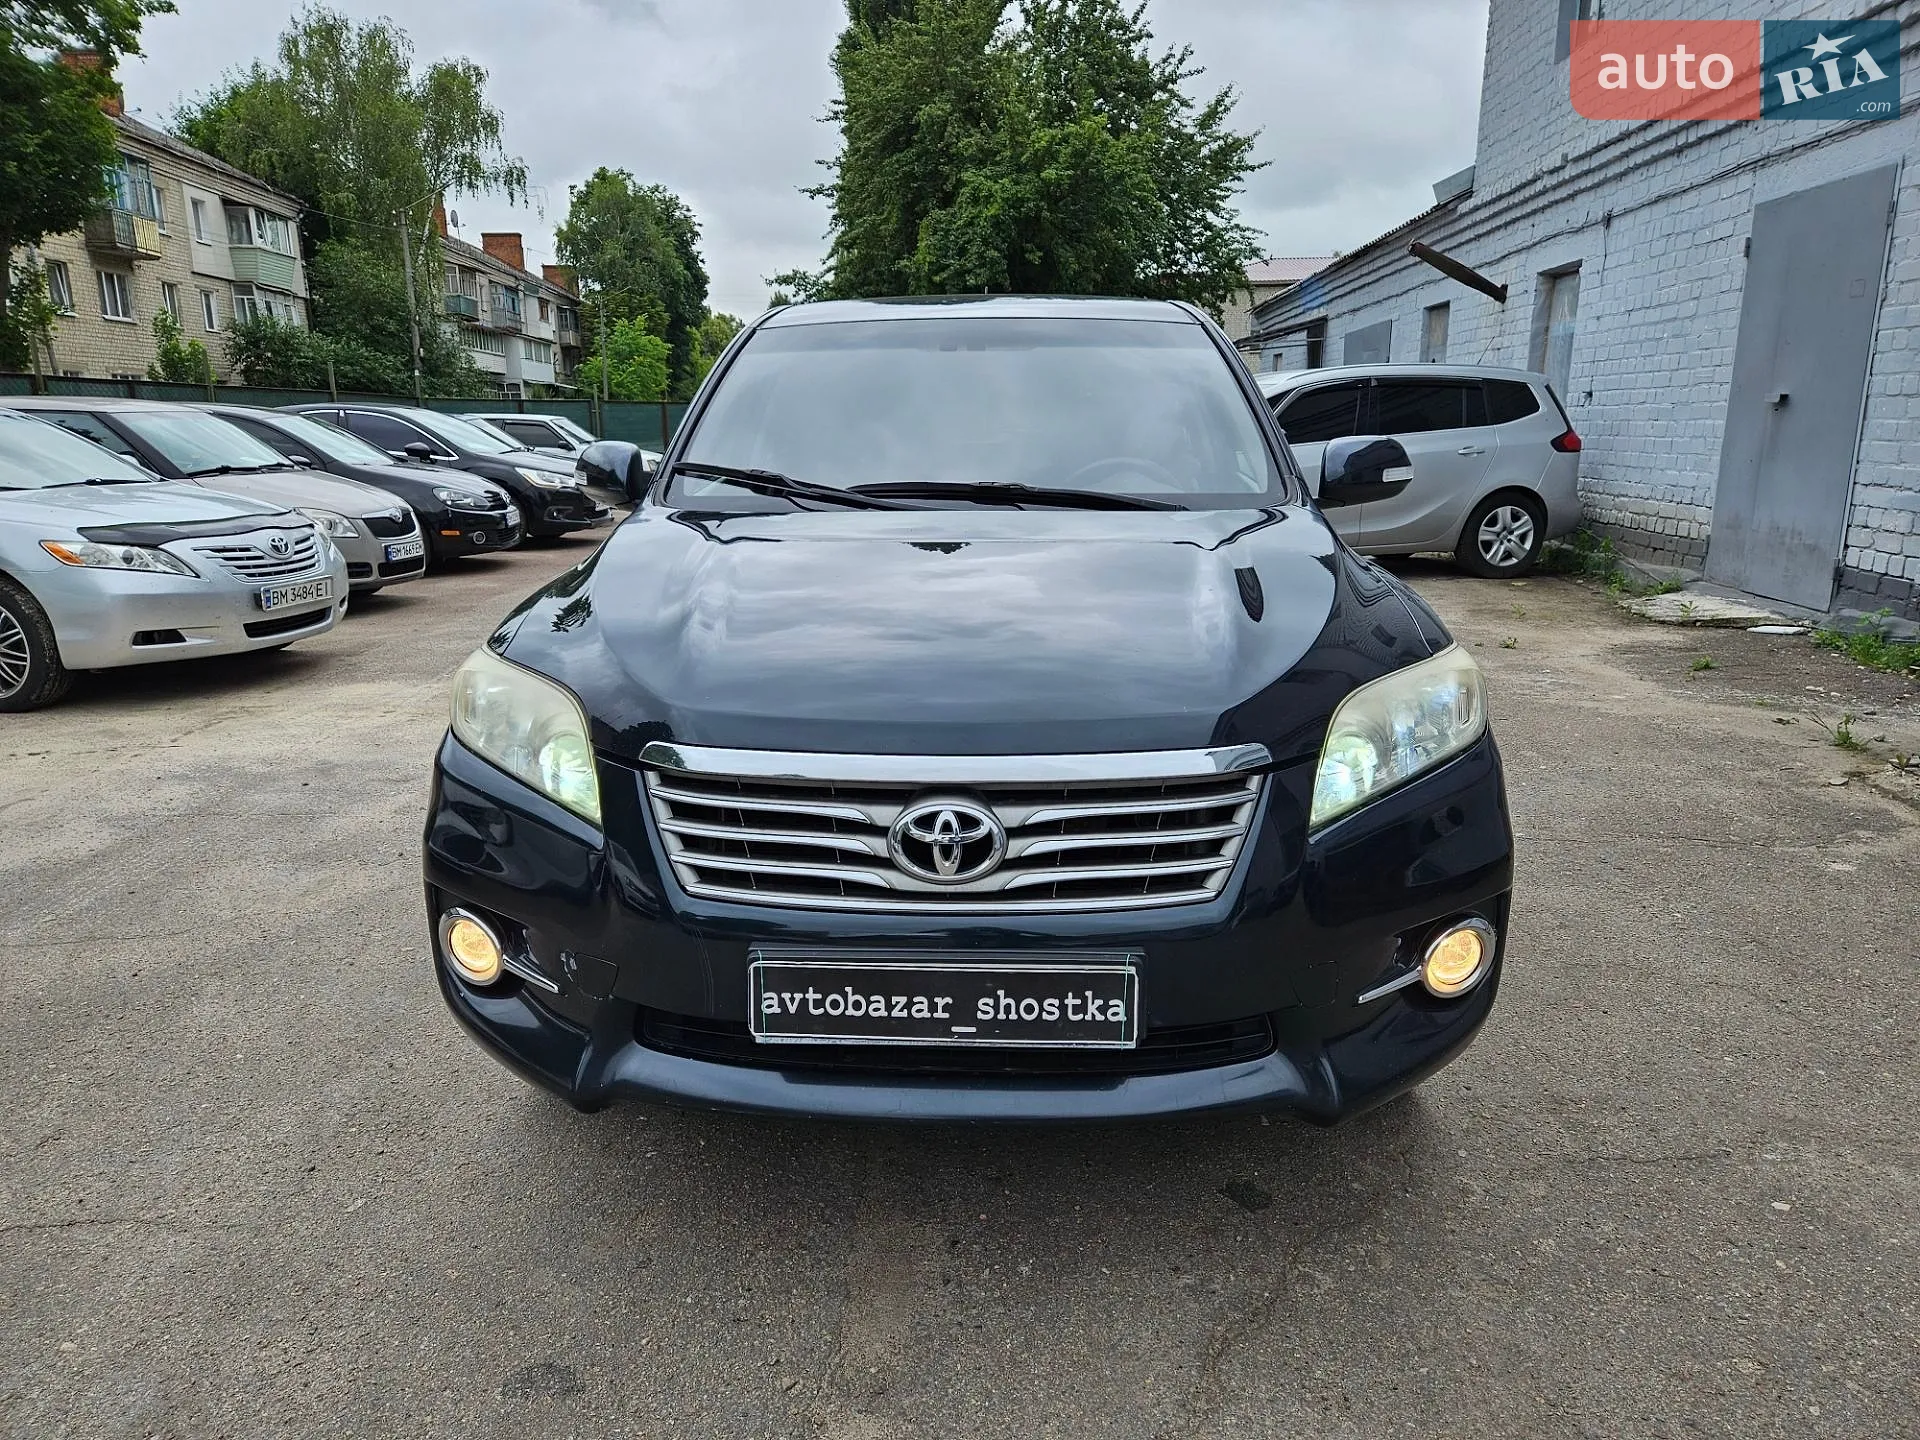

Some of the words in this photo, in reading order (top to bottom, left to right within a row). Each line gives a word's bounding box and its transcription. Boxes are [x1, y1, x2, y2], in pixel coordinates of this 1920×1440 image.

[272, 588, 288, 606] BM
[290, 584, 314, 602] 3484
[316, 582, 328, 597] EI
[761, 986, 1127, 1033] avtobazar_shostka
